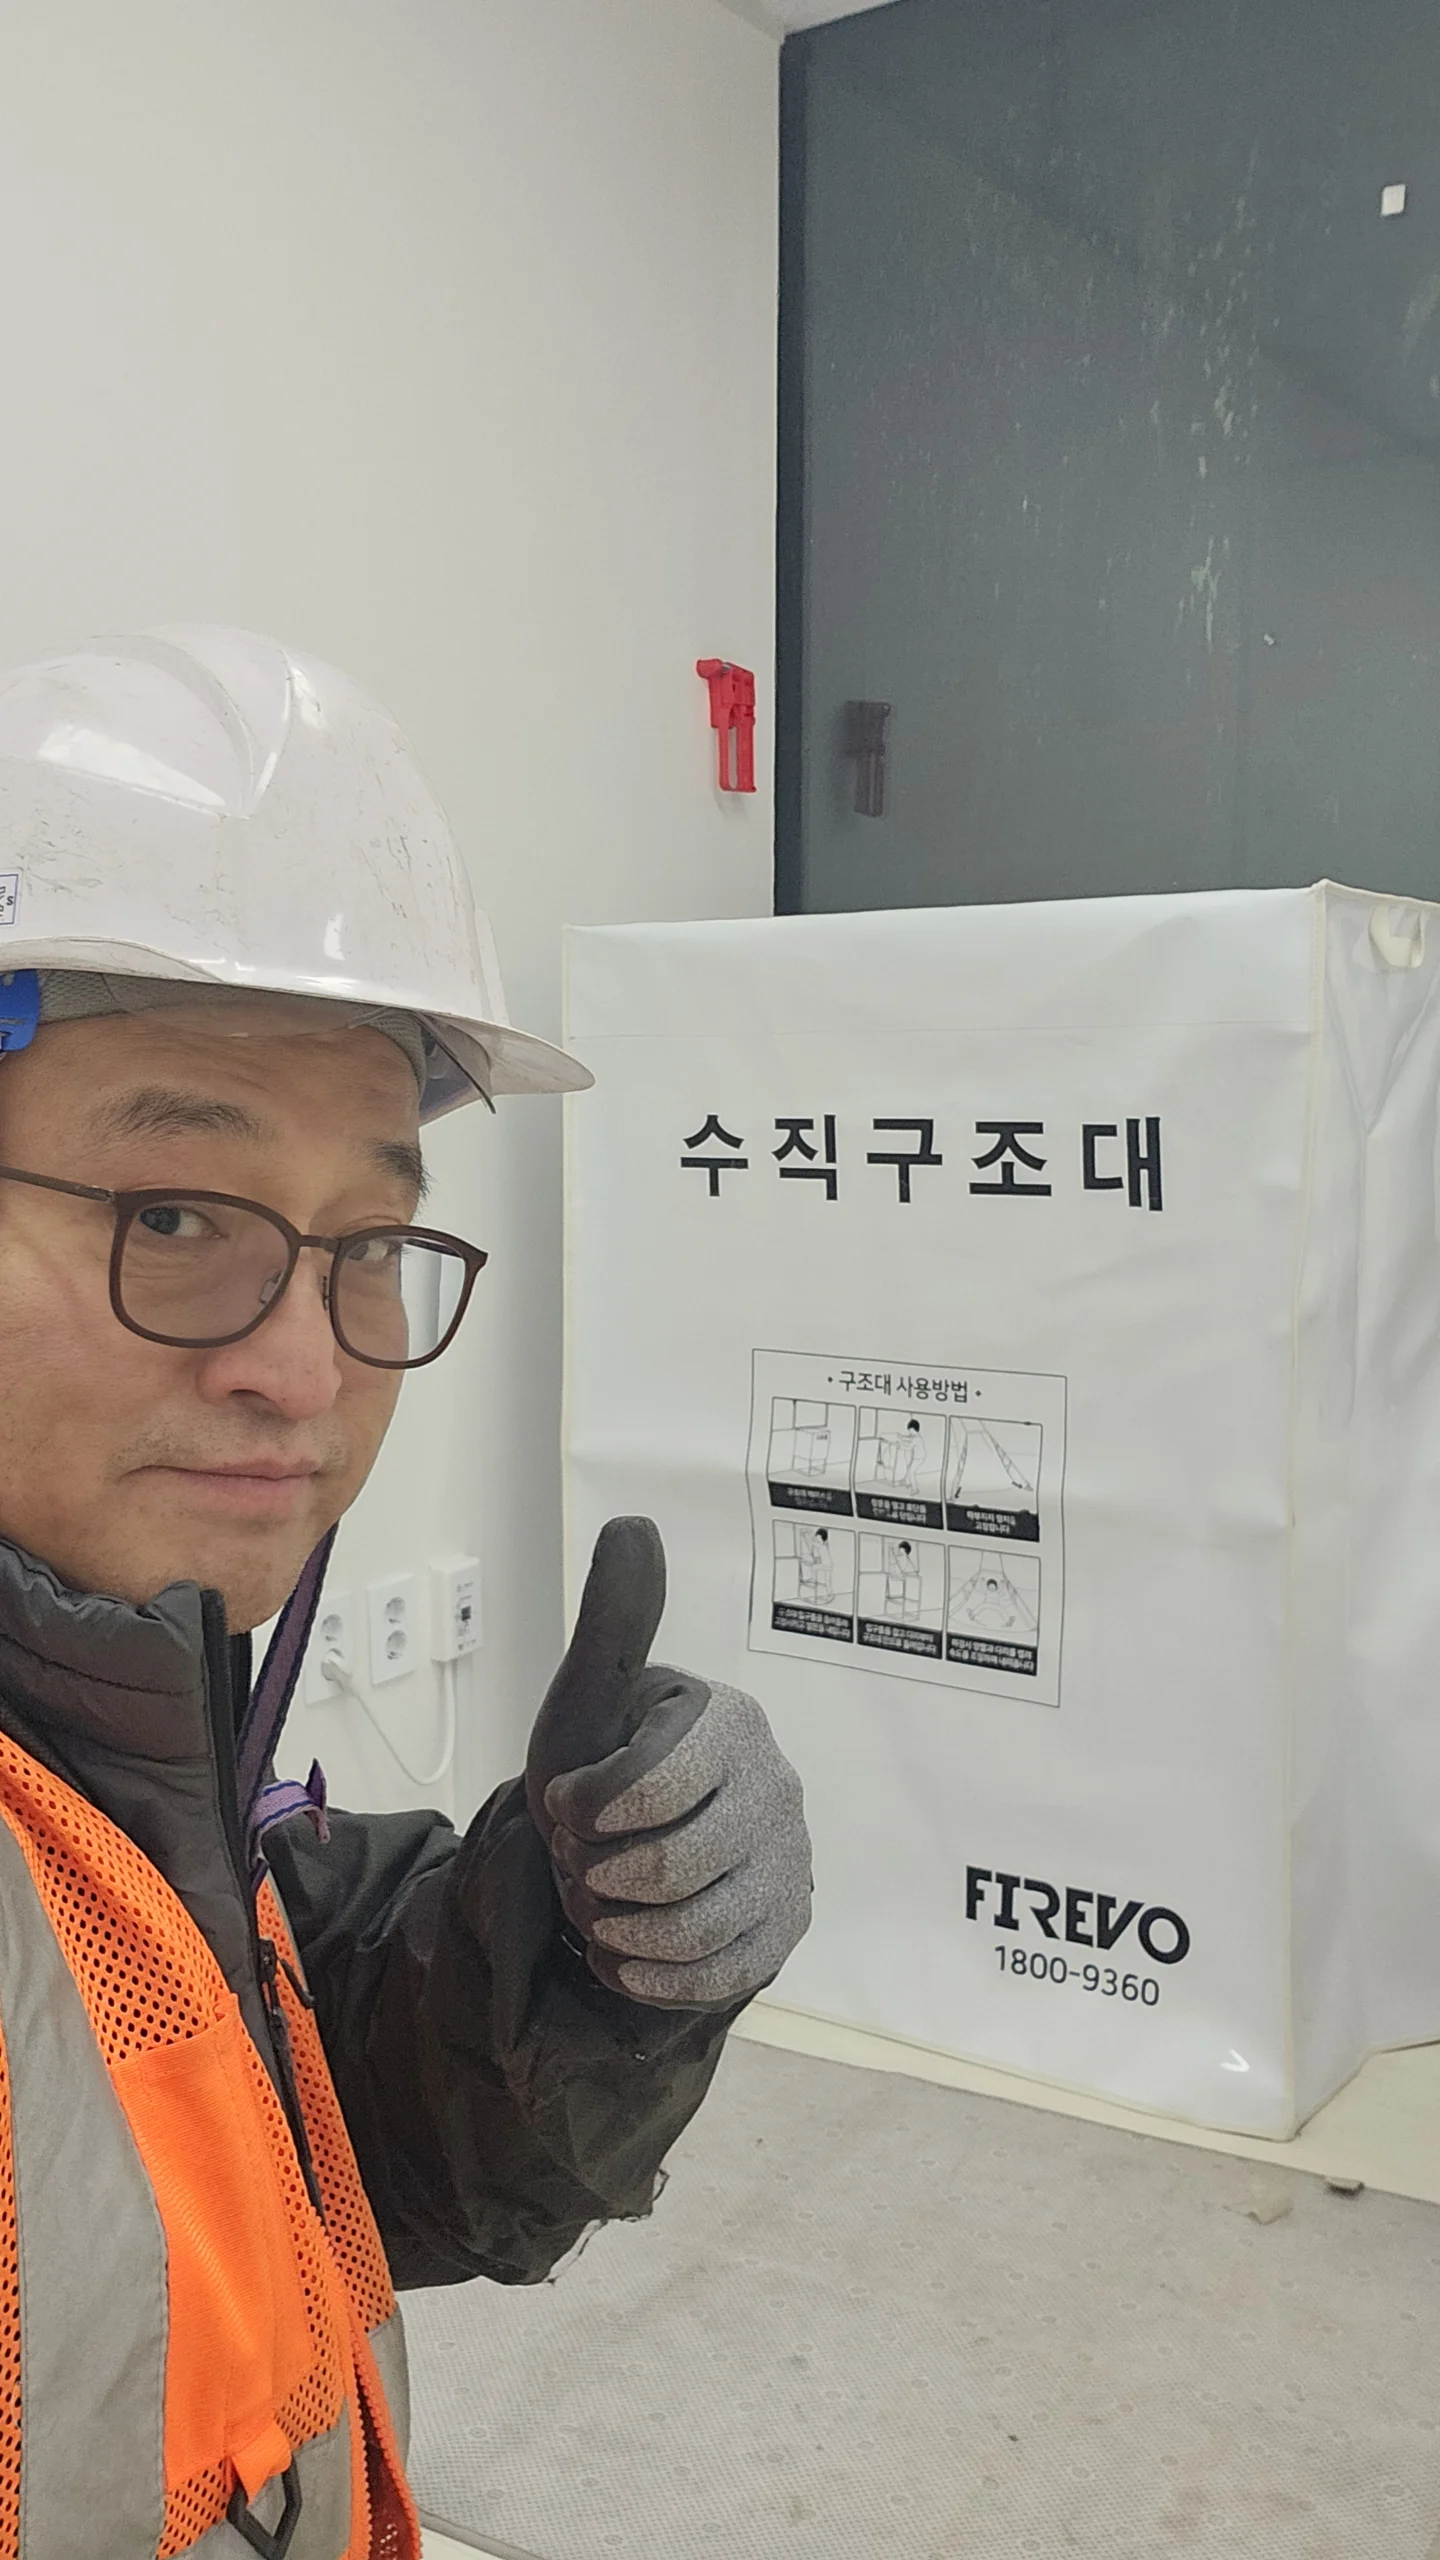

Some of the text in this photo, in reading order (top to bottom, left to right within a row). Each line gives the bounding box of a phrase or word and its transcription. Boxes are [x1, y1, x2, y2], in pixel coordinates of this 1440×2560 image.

[680, 1113, 1164, 1212] 수직구조대
[838, 1370, 968, 1403] 구조대 사용방법
[965, 1865, 1191, 1965] FIREVO
[994, 1945, 1160, 2007] 1800-9360
